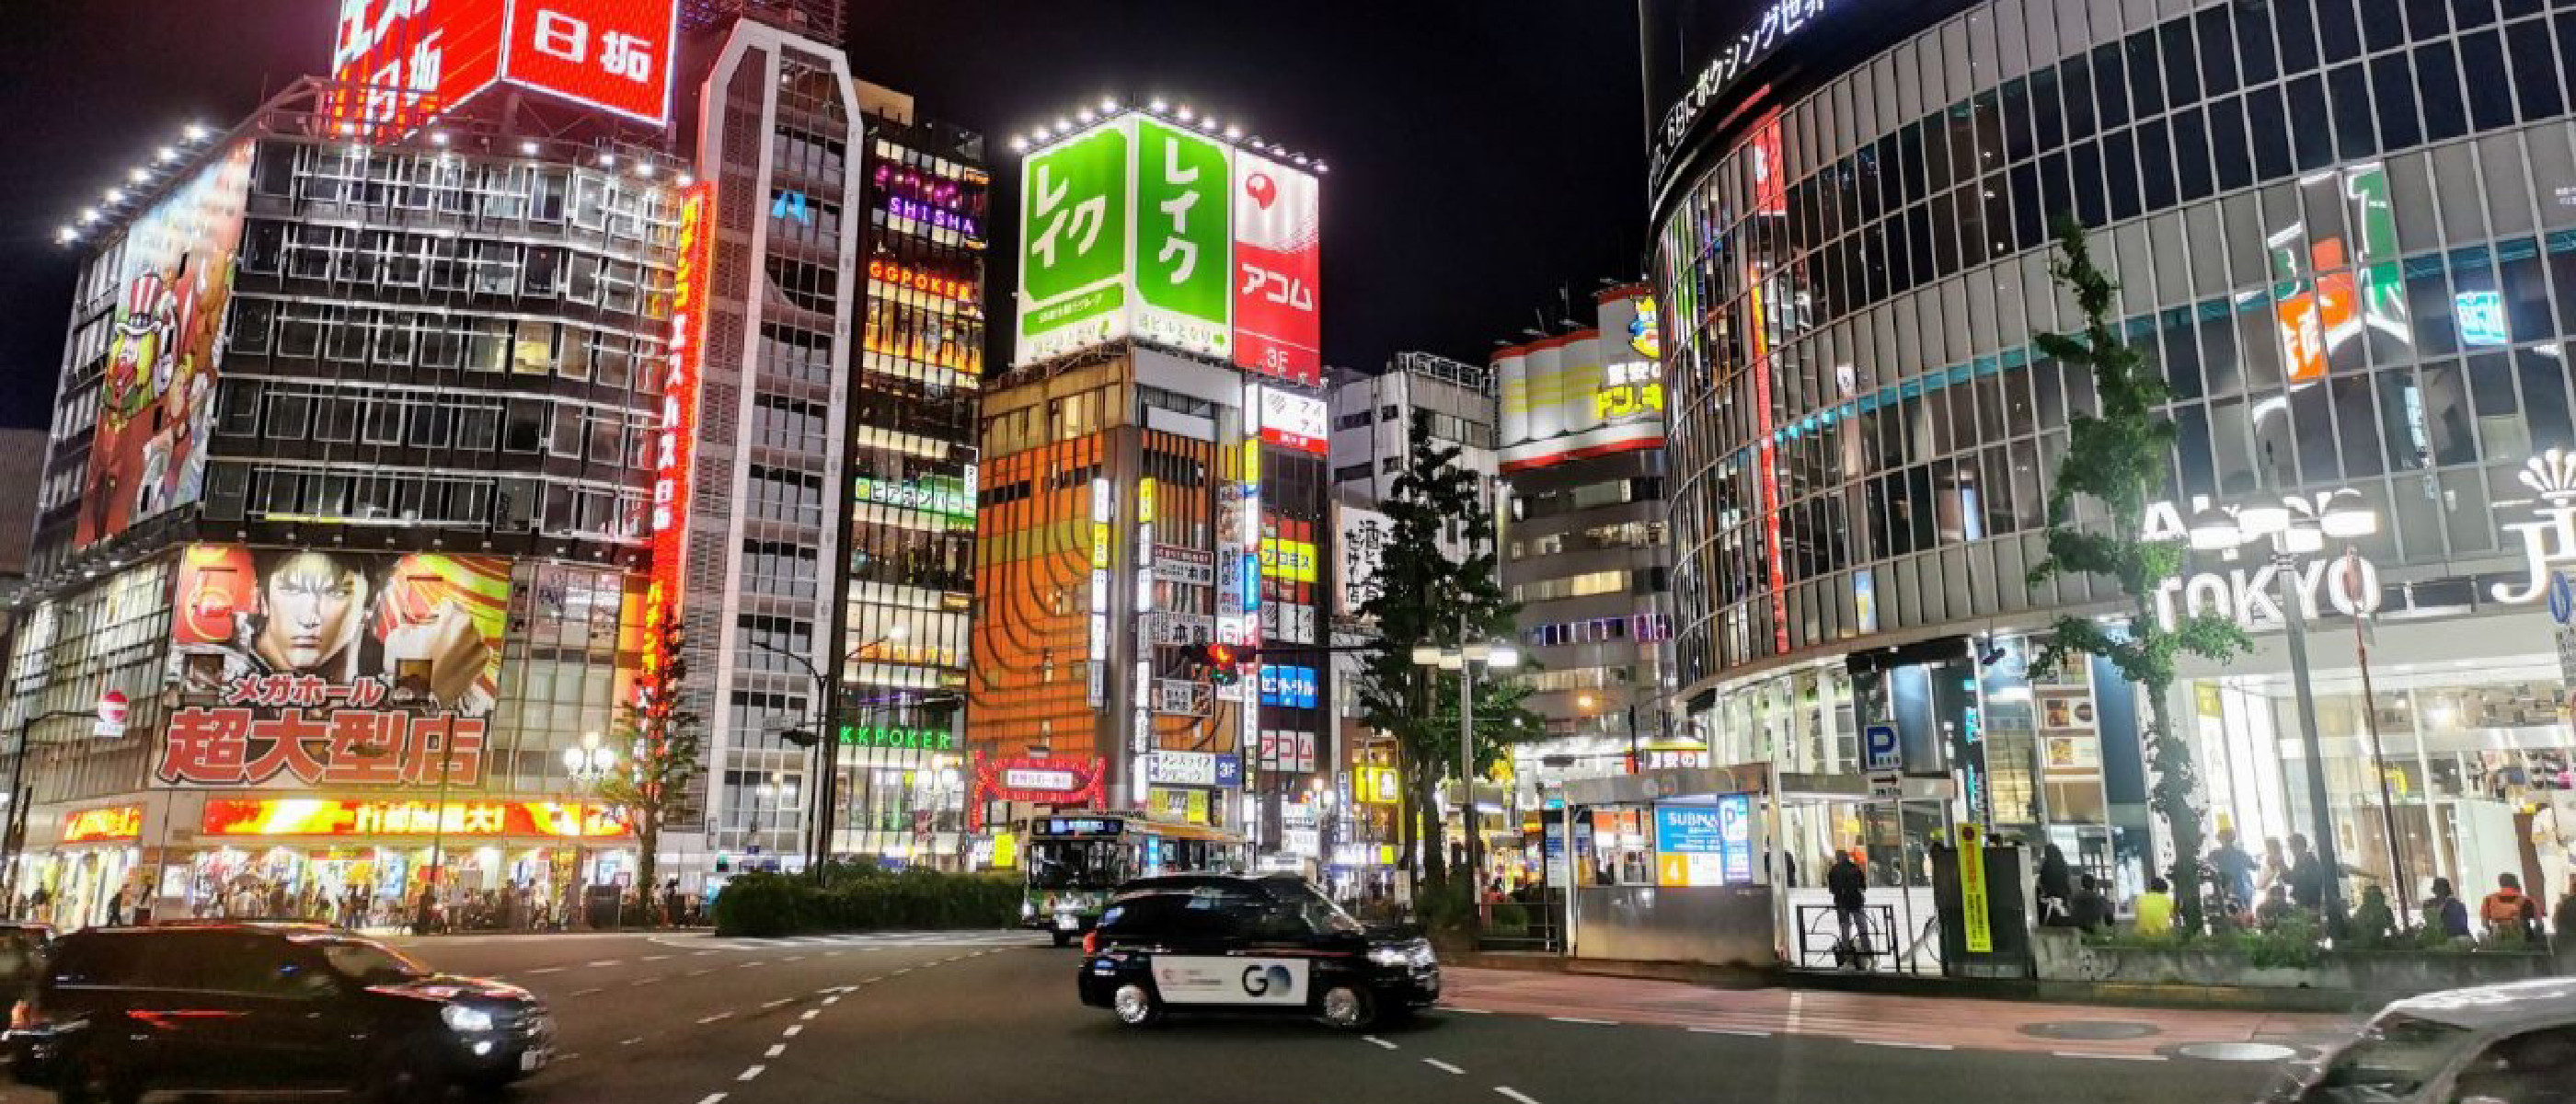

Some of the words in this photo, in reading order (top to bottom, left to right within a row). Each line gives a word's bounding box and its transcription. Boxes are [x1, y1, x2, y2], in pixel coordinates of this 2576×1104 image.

[534, 8, 651, 83] 日拓
[889, 196, 975, 235] SHISHA
[1030, 164, 1106, 269] レイク
[1158, 135, 1201, 285] レイク
[869, 260, 971, 302] GGPOKER
[1241, 262, 1313, 312] アコム
[1266, 346, 1289, 370] 3F
[1261, 547, 1310, 570] プロミス
[2154, 555, 2382, 634] TOKYO
[226, 673, 385, 707] メガホール
[1261, 673, 1314, 696] セントラル
[158, 707, 486, 785] 超大型店
[839, 725, 951, 751] KKPOKER
[1261, 736, 1313, 762] アコム
[1867, 726, 1895, 766] P
[1219, 761, 1236, 779] 3F
[1242, 964, 1292, 998] GO
